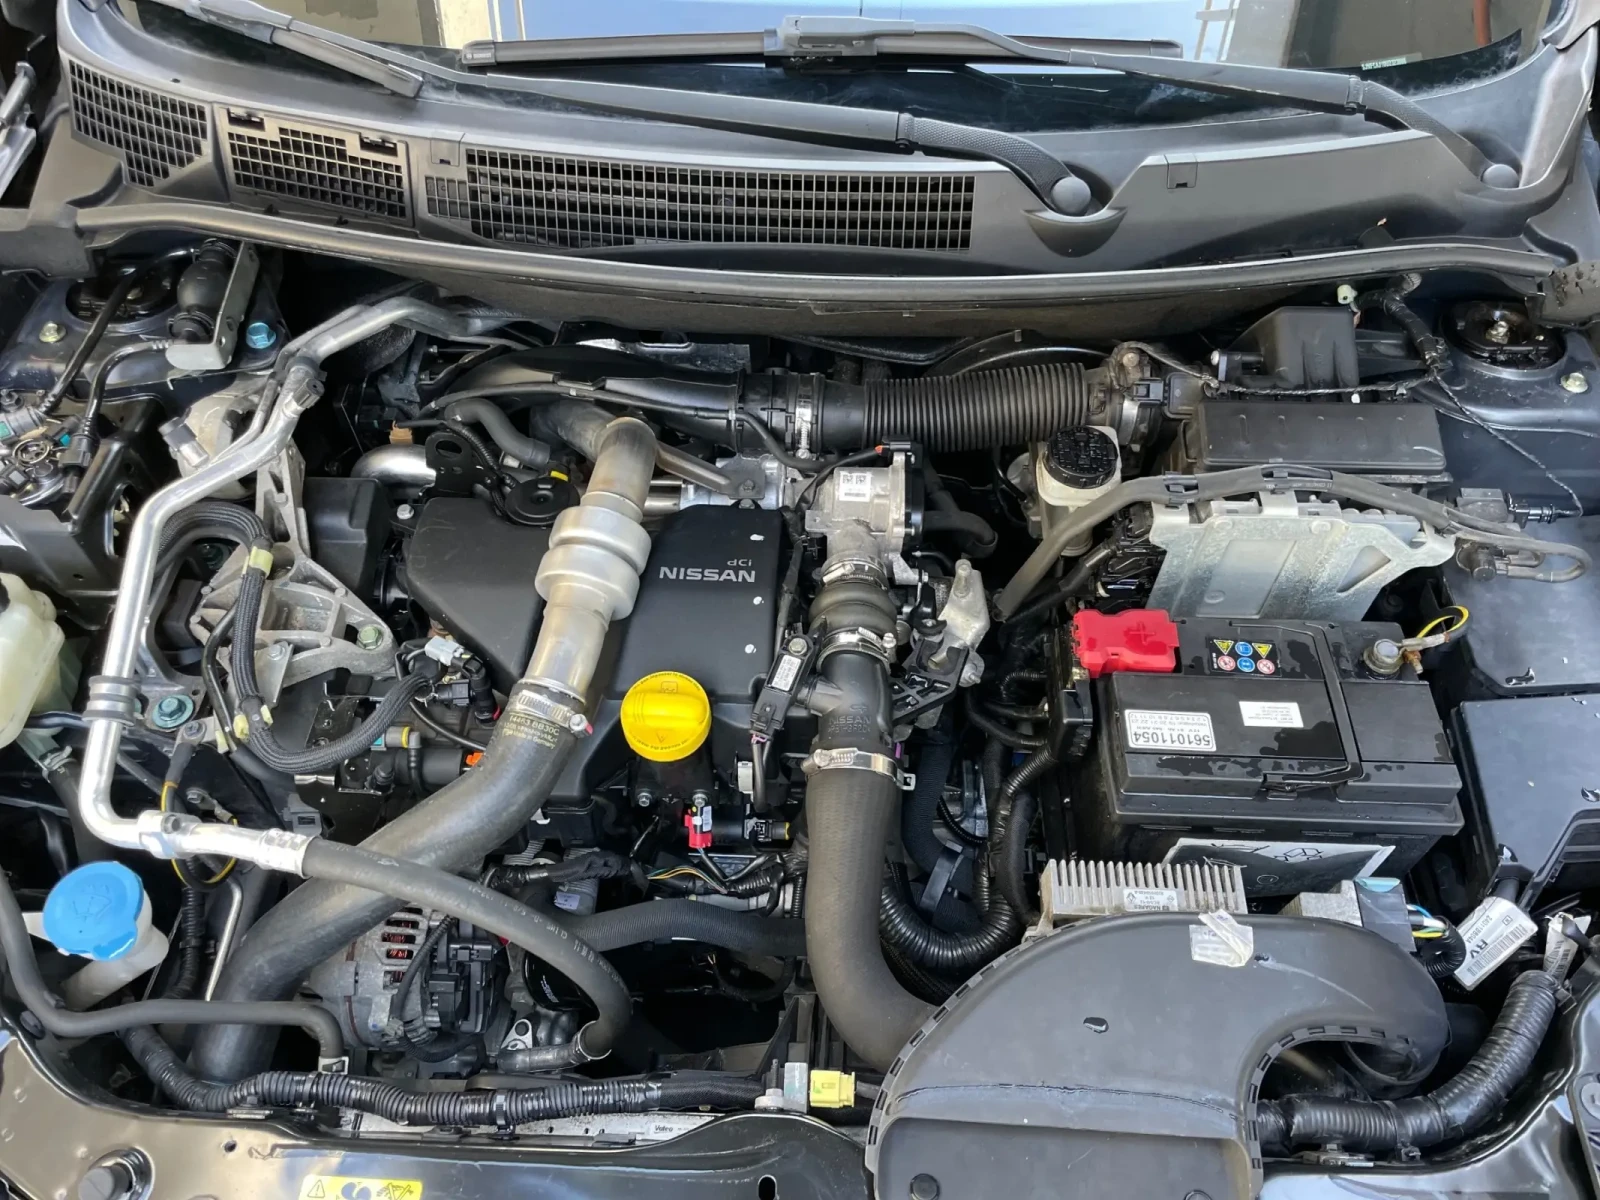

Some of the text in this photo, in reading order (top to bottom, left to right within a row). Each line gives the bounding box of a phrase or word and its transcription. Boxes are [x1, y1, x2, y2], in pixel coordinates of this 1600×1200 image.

[727, 559, 752, 567] dCi
[659, 566, 756, 583] NISSAN
[829, 715, 872, 725] NISSAN
[1133, 731, 1210, 746] 561011054
[1470, 938, 1489, 959] RV
[654, 1124, 674, 1132] Valeo
